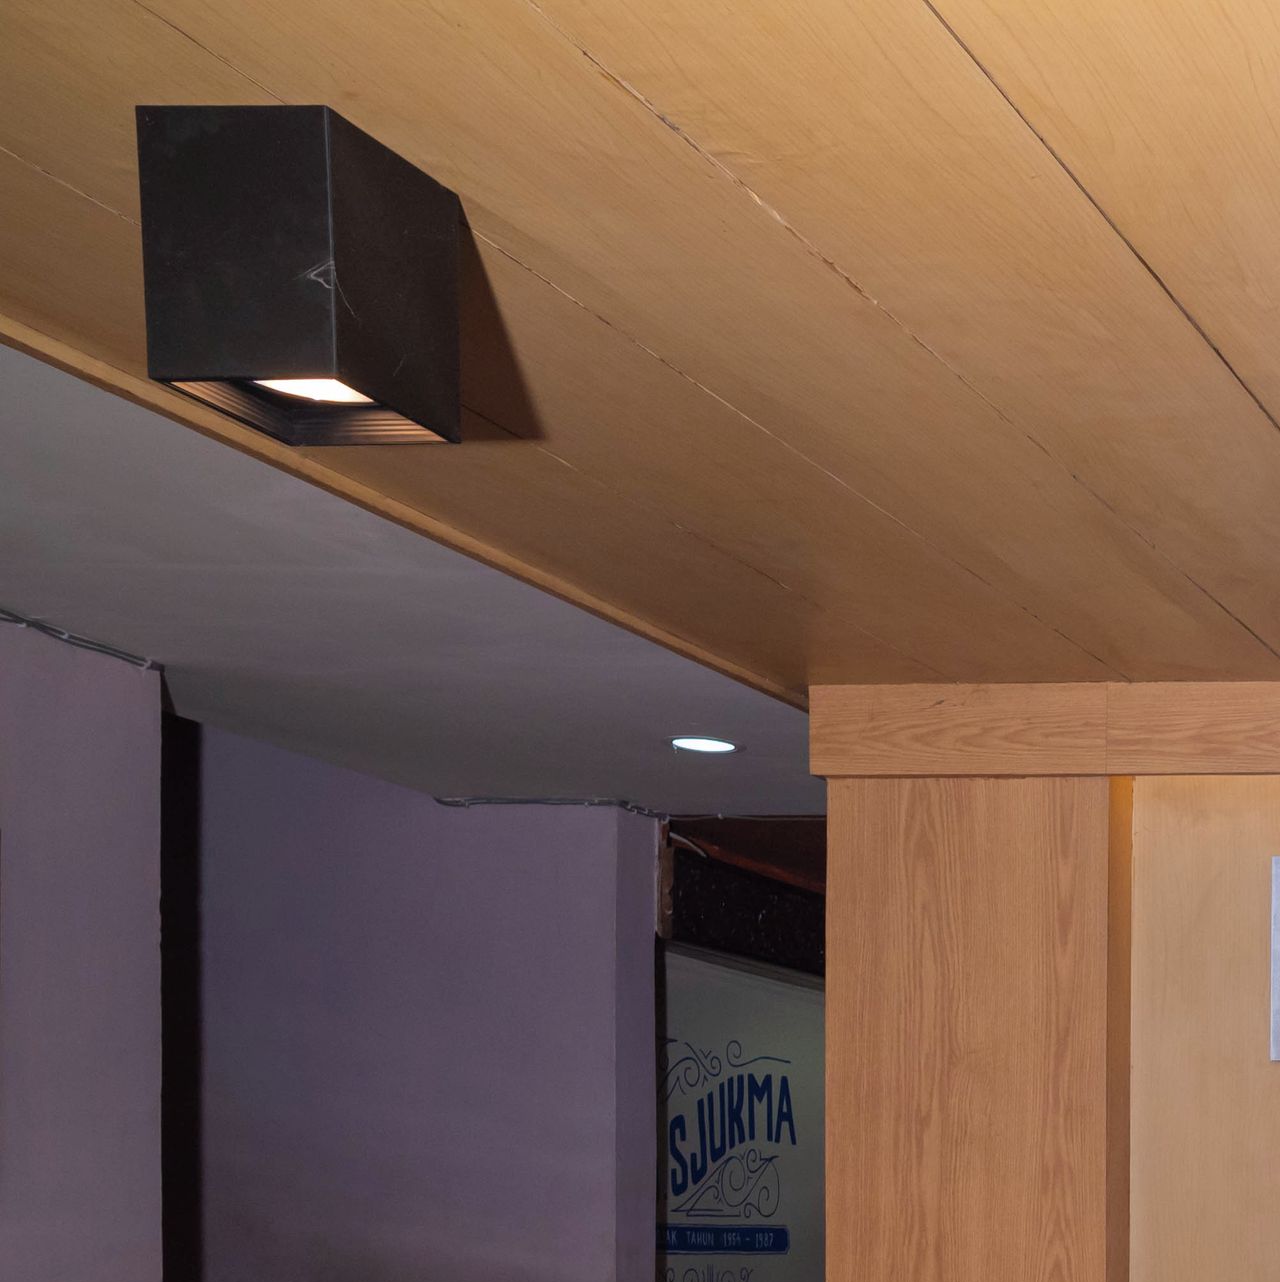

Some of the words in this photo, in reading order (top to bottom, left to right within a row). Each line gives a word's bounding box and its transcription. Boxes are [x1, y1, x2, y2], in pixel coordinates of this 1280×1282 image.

[669, 1072, 797, 1197] SJUKMA
[687, 1231, 714, 1247] TAHUN
[755, 1231, 774, 1249] 1987
